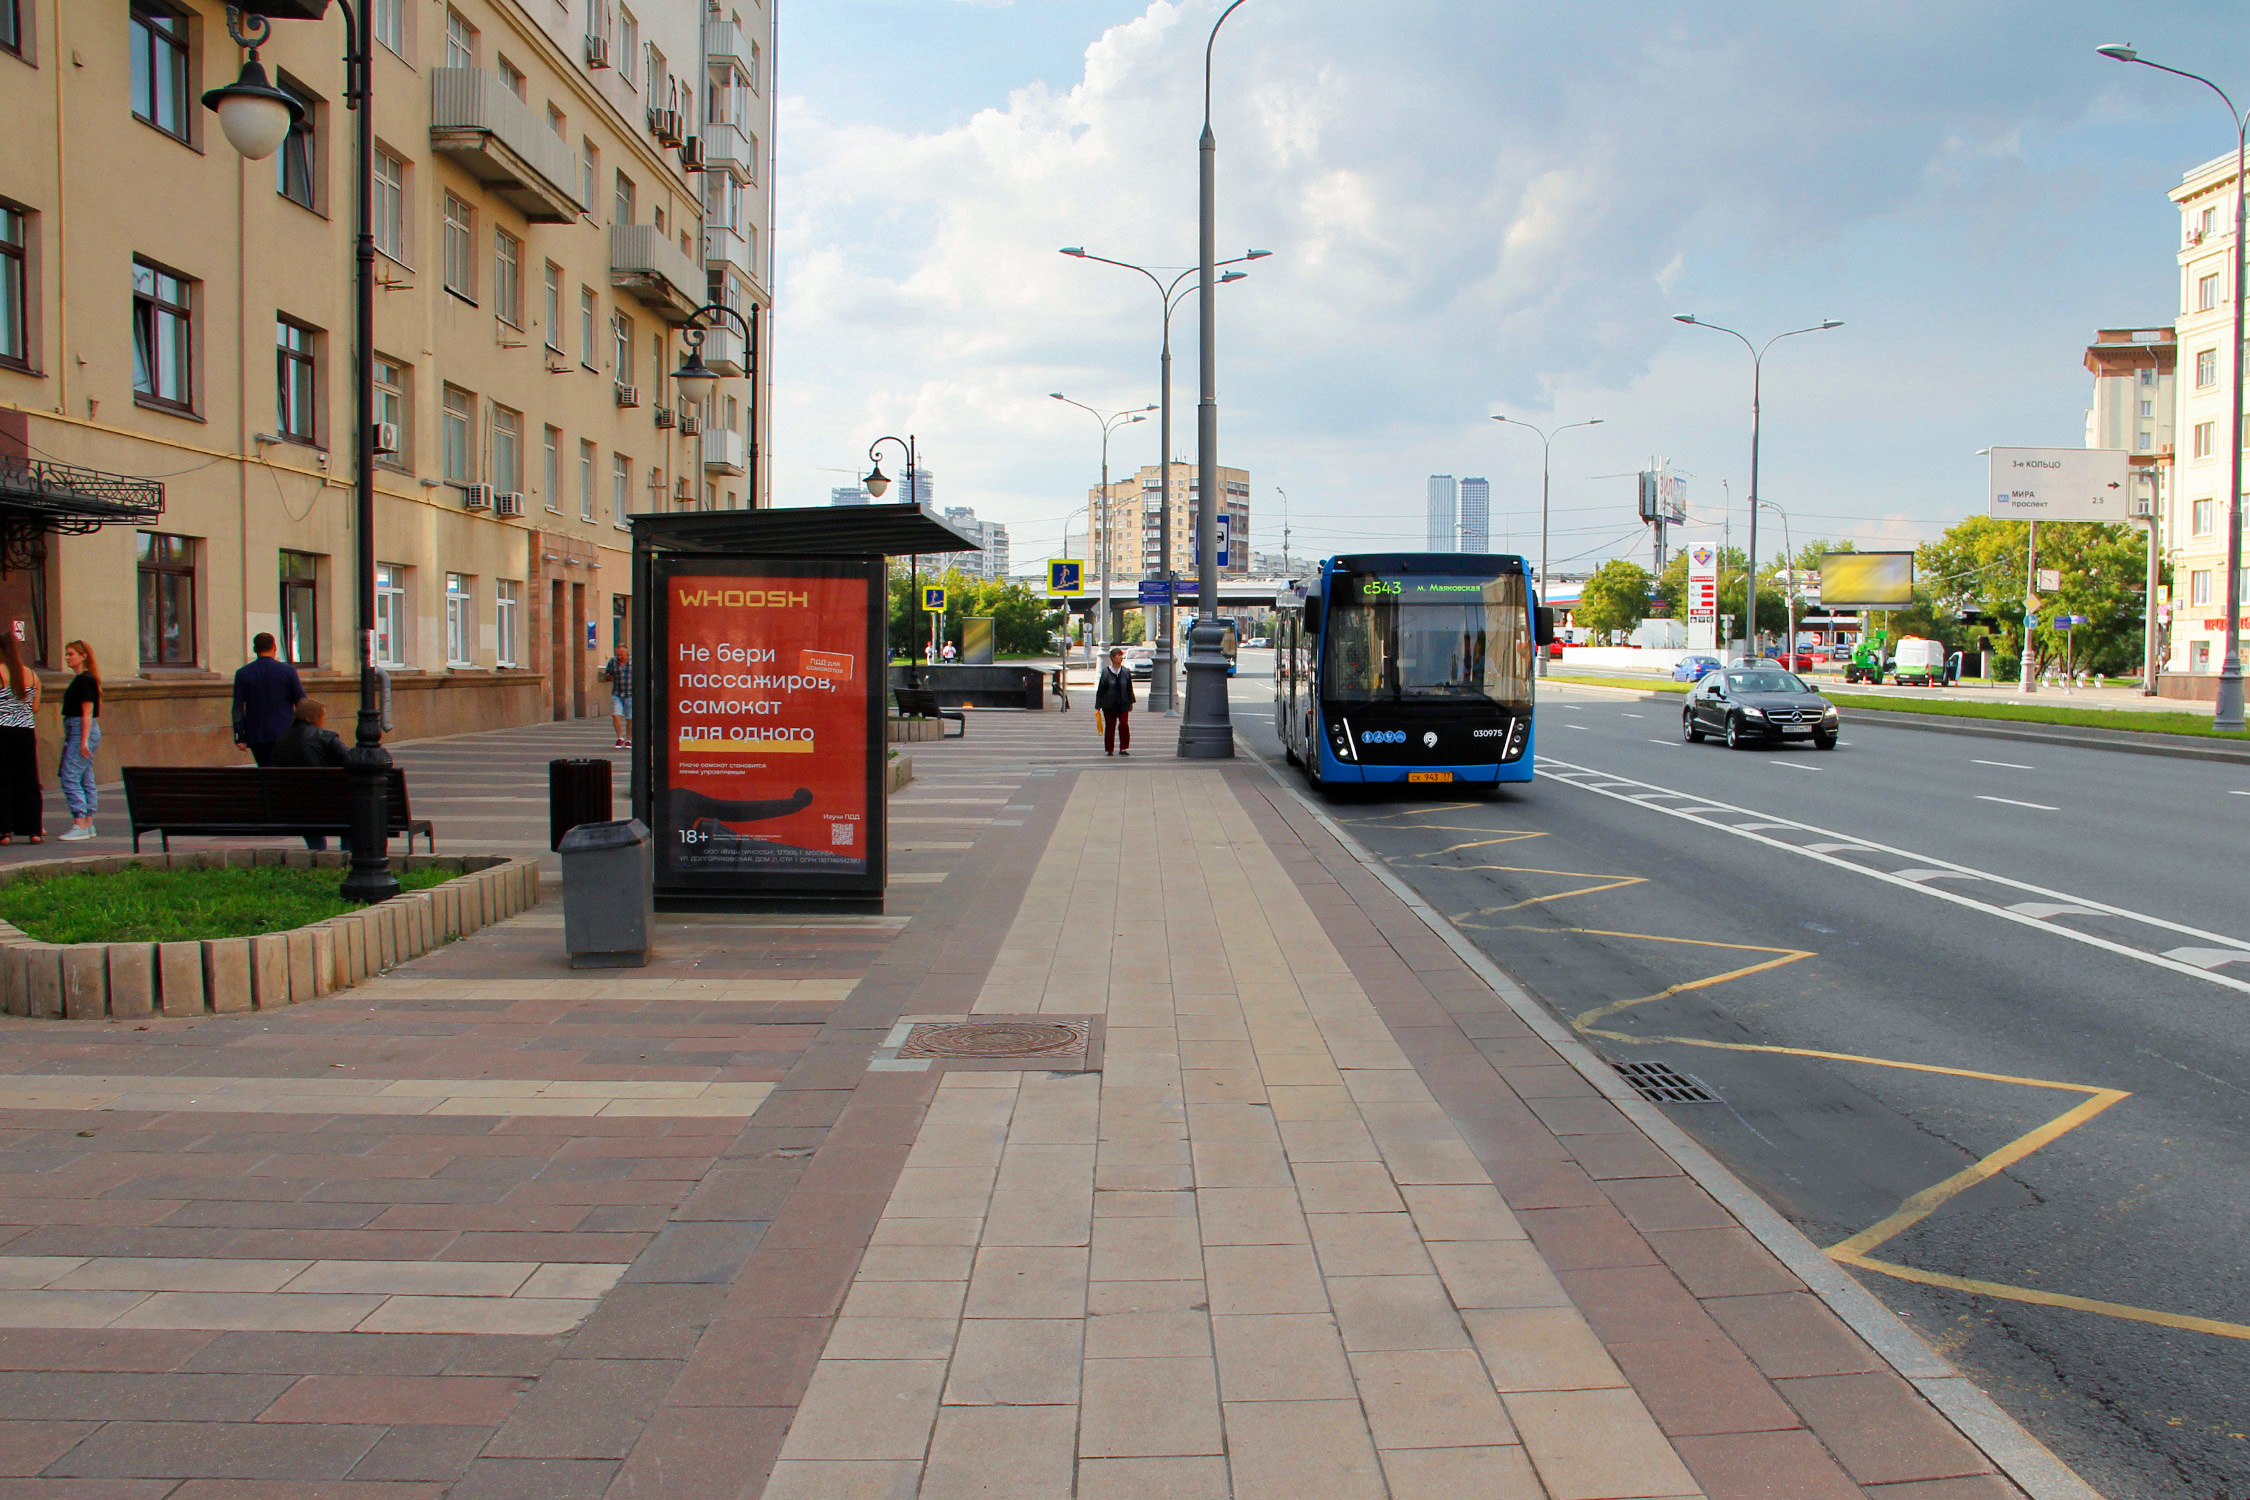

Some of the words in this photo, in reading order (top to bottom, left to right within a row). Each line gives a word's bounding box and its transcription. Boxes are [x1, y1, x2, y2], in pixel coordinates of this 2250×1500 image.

[2012, 460, 2024, 468] 3-е
[2025, 460, 2061, 470] КОЛЬЦО
[2011, 490, 2035, 498] МИРА
[1363, 581, 1402, 594] с543
[1429, 584, 1481, 592] Маяковская
[679, 590, 808, 608] WHOOSH
[679, 643, 710, 662] Не
[716, 642, 775, 667] бери
[679, 673, 837, 693] пассажиров,
[679, 700, 782, 714] самокат
[679, 726, 722, 743] для
[729, 726, 815, 743] одного
[1473, 729, 1503, 738] 030975
[1424, 773, 1439, 781] 943
[678, 829, 709, 844] 18+
